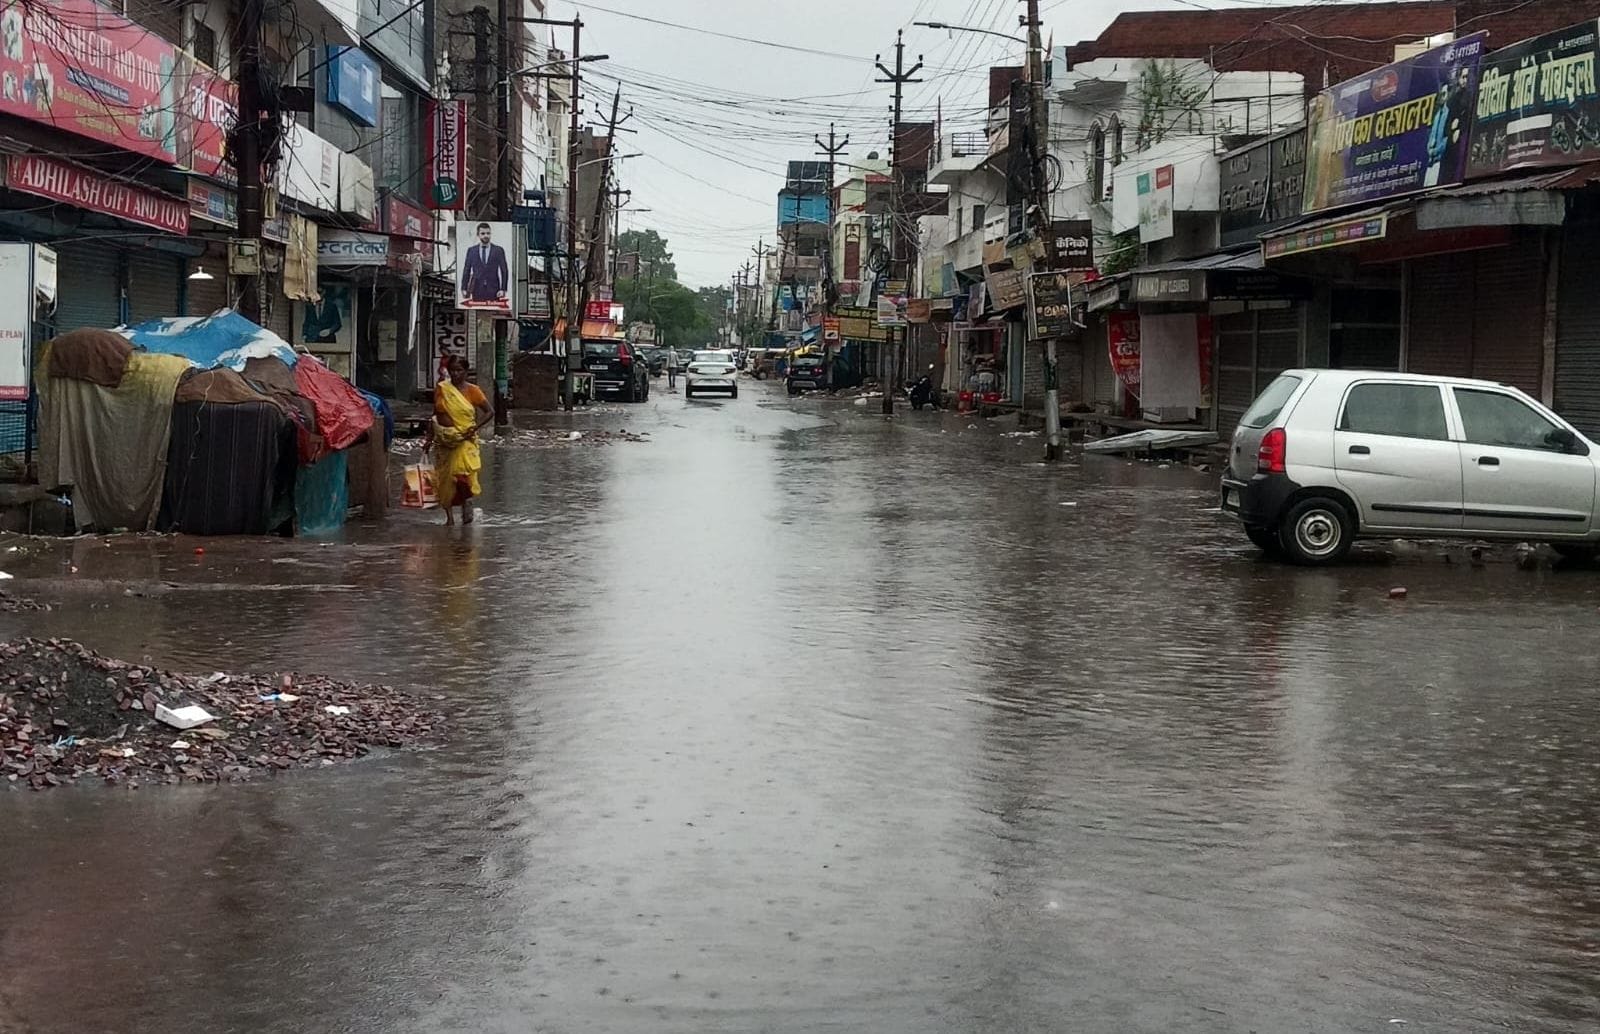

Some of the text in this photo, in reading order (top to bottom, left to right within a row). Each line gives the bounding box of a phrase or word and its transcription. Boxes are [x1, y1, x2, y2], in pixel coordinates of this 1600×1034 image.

[88, 31, 113, 73] GIFT
[113, 46, 136, 84] AND
[137, 55, 161, 93] TOYS
[1510, 54, 1539, 110] ऑटो
[22, 157, 101, 206] ABHILASH
[103, 180, 131, 214] GIFT
[132, 195, 159, 220] AND
[161, 201, 188, 230] TOYS
